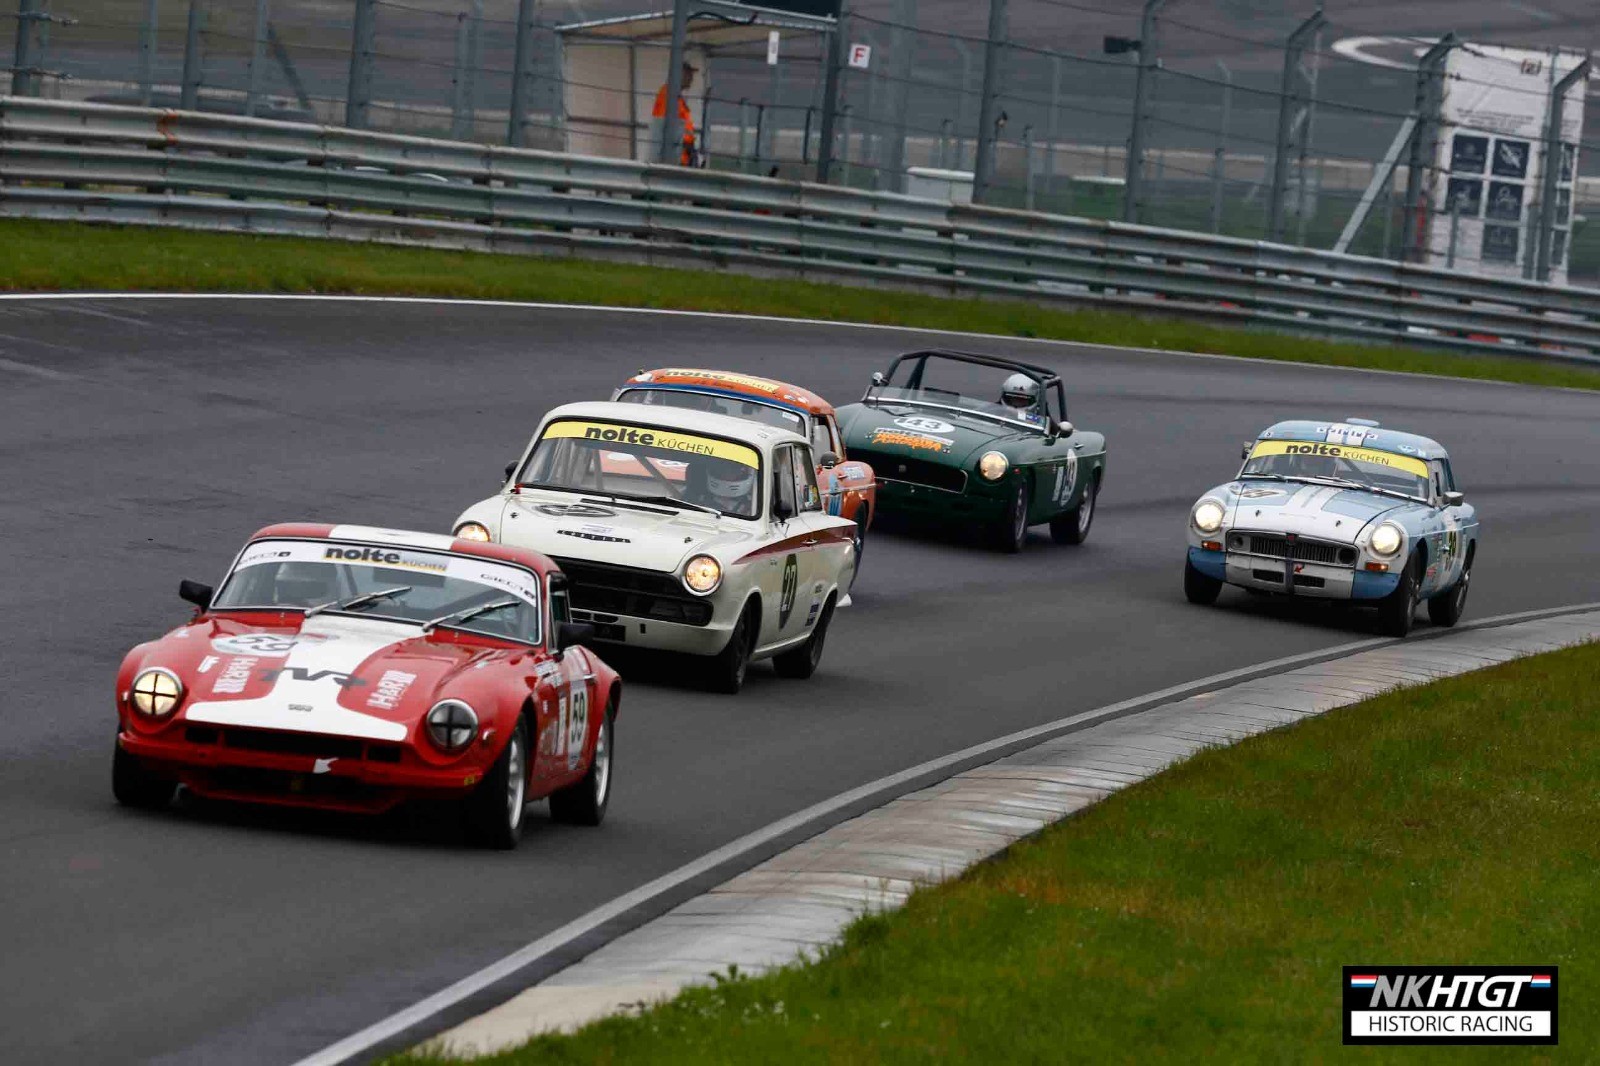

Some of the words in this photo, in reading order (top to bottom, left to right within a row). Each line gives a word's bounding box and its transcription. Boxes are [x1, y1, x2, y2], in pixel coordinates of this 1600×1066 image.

[853, 47, 865, 63] F
[585, 426, 655, 446] nolte
[657, 438, 715, 456] KÜCHEN
[1286, 443, 1341, 457] nolte
[1343, 450, 1390, 466] KÜCHEN
[325, 547, 401, 564] nolte
